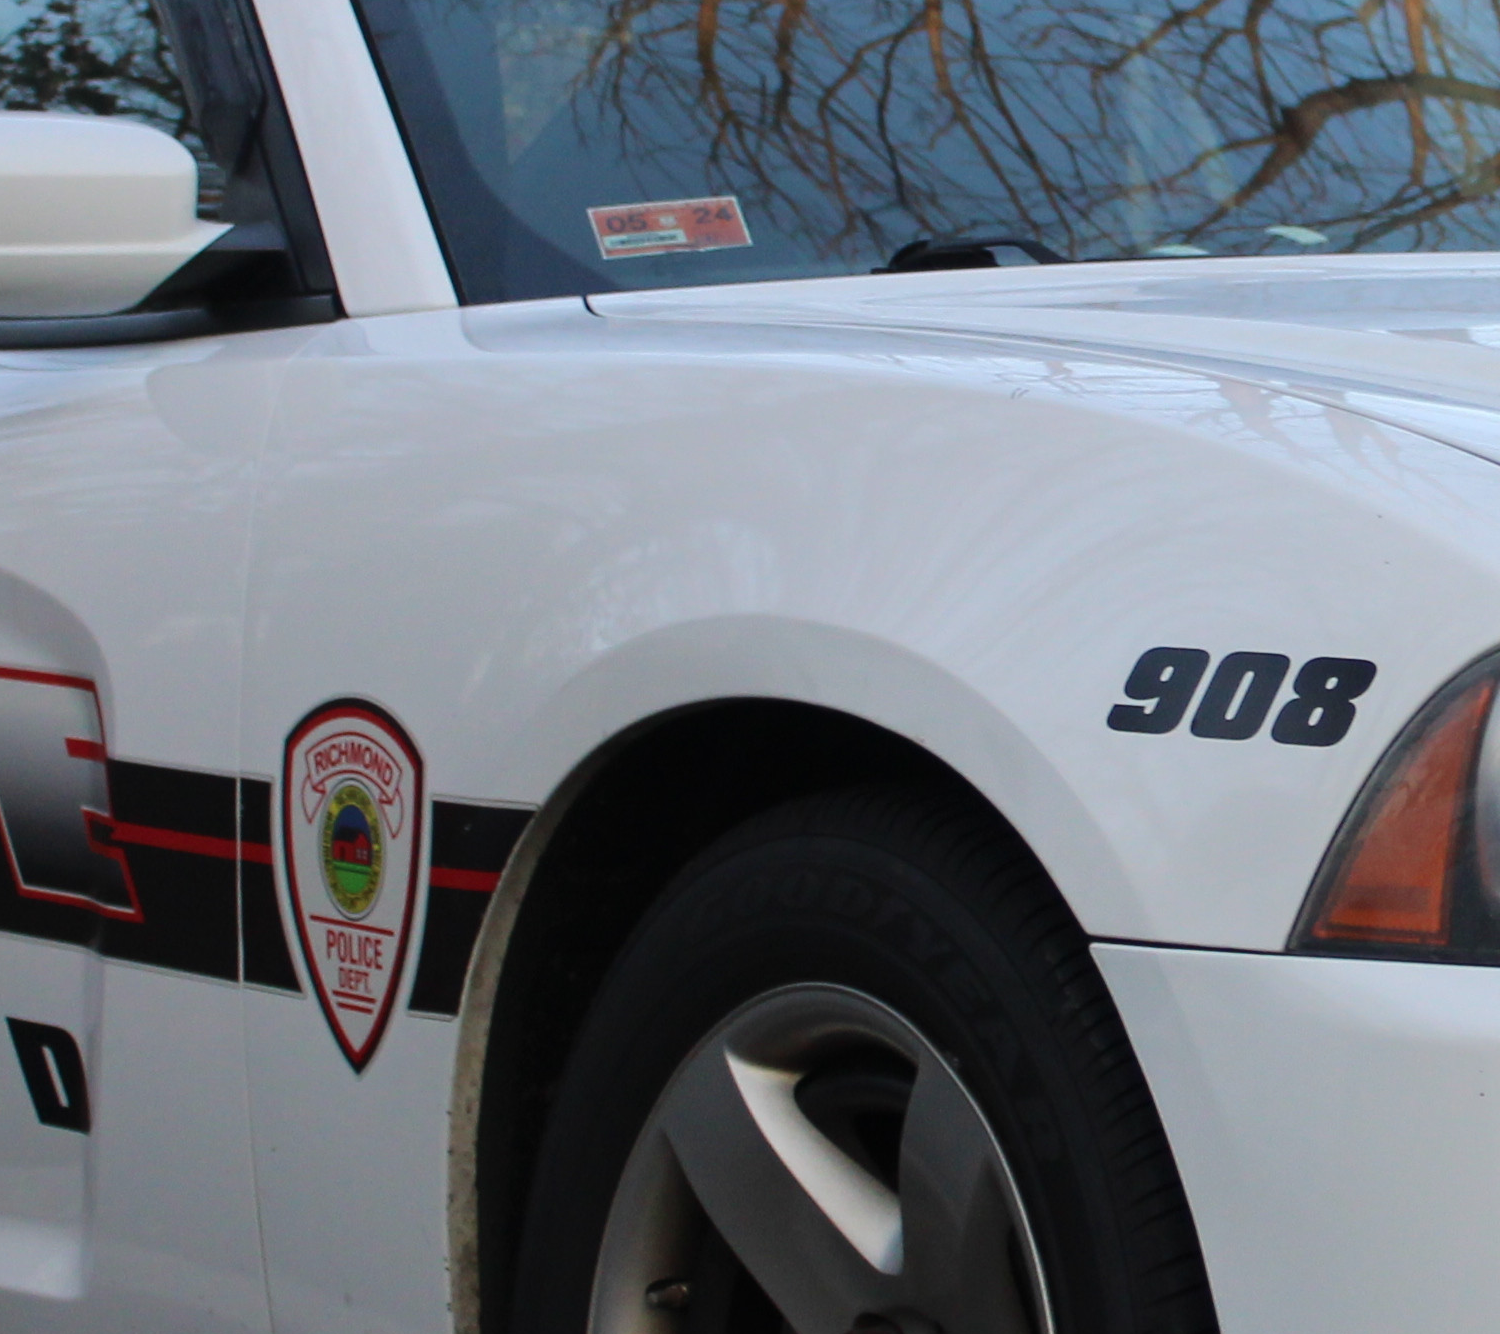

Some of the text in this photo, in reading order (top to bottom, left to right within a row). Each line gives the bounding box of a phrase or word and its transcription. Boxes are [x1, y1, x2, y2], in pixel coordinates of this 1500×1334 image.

[606, 206, 733, 233] 05 24
[1106, 646, 1378, 747] 908
[313, 741, 393, 787] RICHMOND
[326, 928, 383, 970] POLICE
[337, 966, 372, 993] DEPT.
